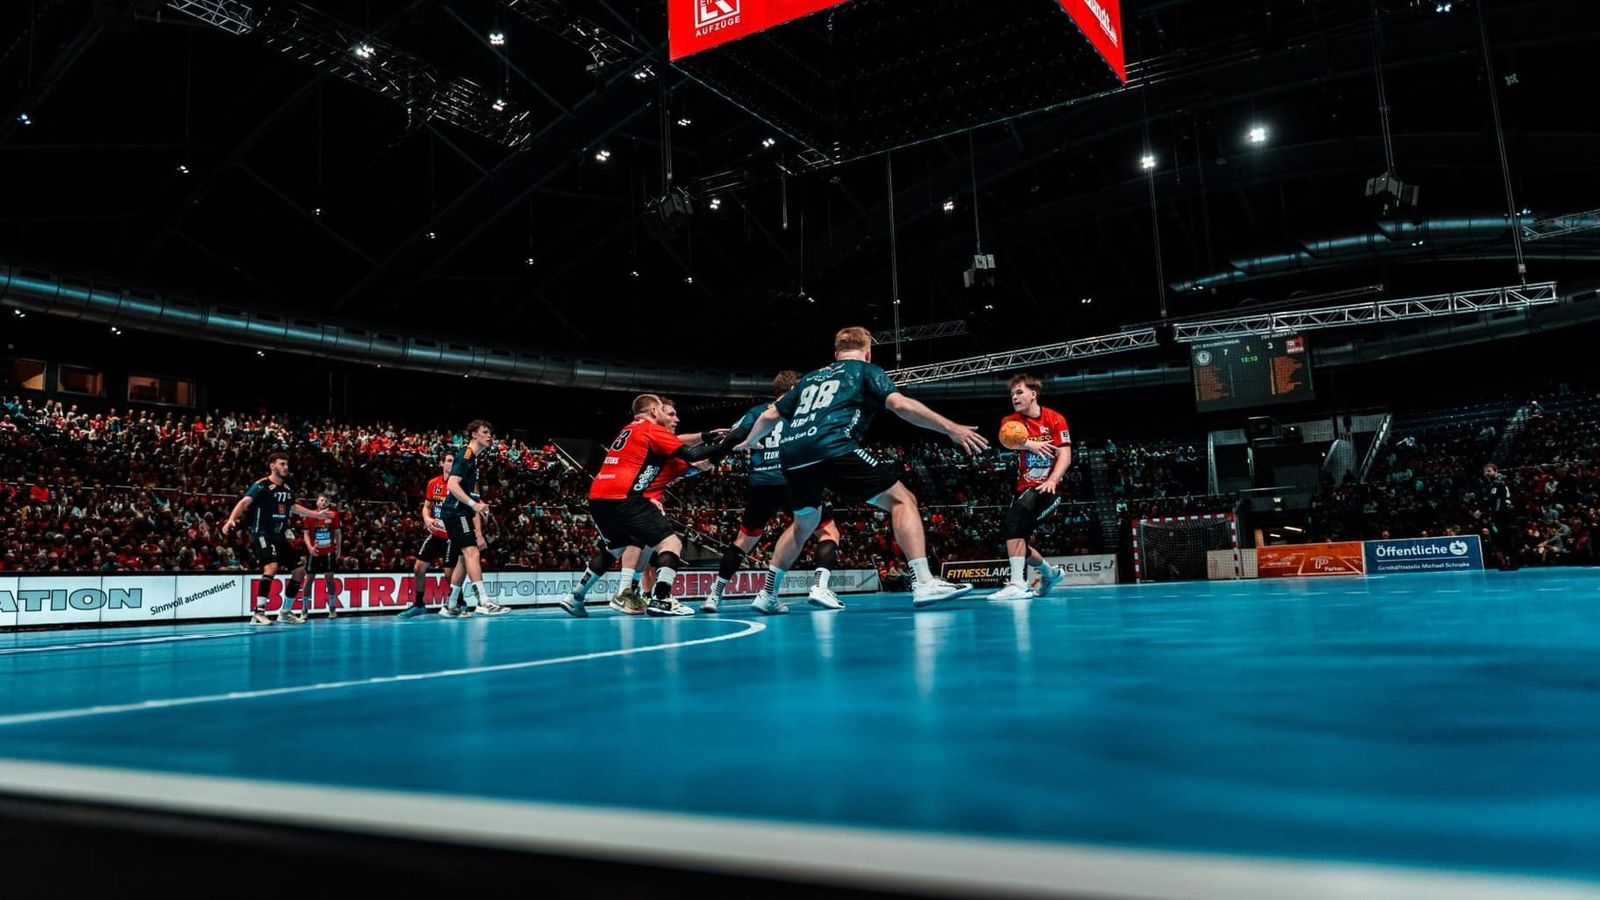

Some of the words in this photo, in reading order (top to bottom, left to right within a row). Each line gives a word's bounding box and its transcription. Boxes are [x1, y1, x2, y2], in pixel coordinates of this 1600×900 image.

[696, 15, 741, 37] AUFZÜGE
[793, 380, 840, 417] 98
[277, 491, 287, 502] 77
[1376, 545, 1448, 557] Öffentliche
[463, 580, 621, 598] AUTOMAON
[671, 573, 766, 596] BERRAM
[0, 588, 142, 612] ATION
[150, 596, 184, 616] Sinnvoll
[184, 579, 236, 604] automatisiert
